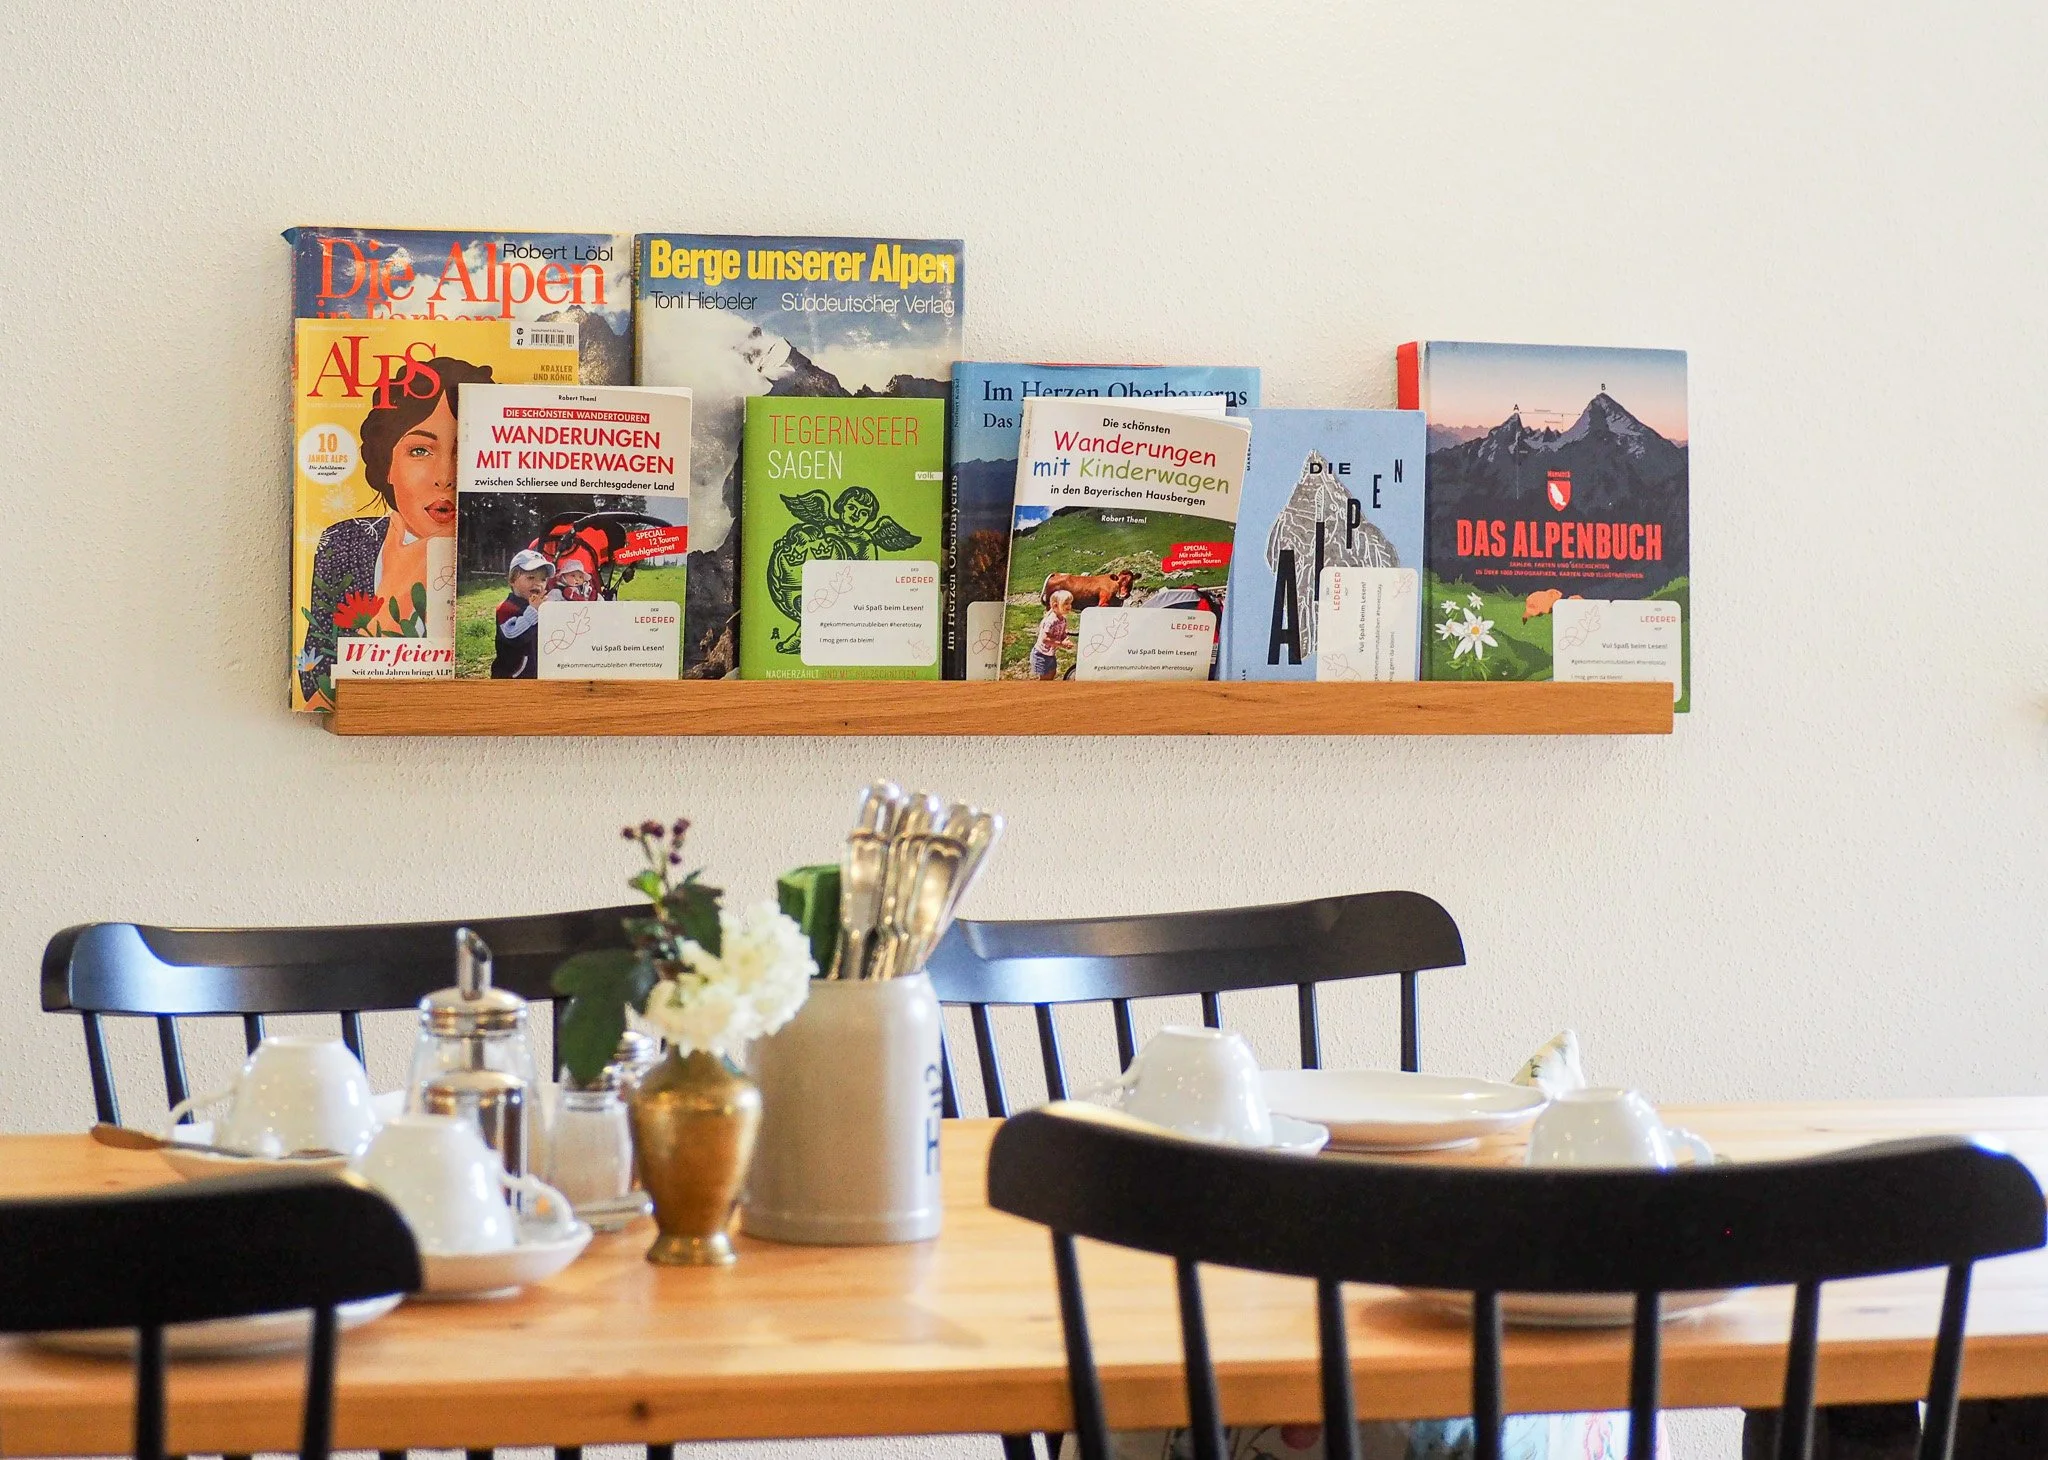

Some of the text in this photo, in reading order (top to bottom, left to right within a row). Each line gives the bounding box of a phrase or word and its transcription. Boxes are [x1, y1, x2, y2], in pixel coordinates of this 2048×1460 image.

[502, 243, 614, 262] Robert Löbl
[650, 239, 955, 289] Berge unserer Alpen
[315, 238, 415, 301] Die
[427, 241, 608, 319] Alpen
[649, 291, 758, 311] Toni Hiebeler
[781, 292, 956, 317] Süddeutscher Verlag
[516, 338, 524, 346] 47
[307, 335, 440, 410] ALPS
[540, 364, 573, 373] KRAXLER
[533, 373, 573, 381] UND KÖNIG
[983, 380, 1013, 401] Im
[1021, 380, 1099, 398] Herzen
[1513, 403, 1520, 411] A
[506, 408, 648, 423] DIE SCHÖNSTEN WANDERTOUREN
[983, 413, 1013, 428] Das
[769, 415, 918, 446] TEGERNSEER
[1102, 418, 1171, 435] Die schönsten
[318, 433, 338, 453] 10
[491, 425, 661, 450] WANDERUNGEN
[1054, 430, 1216, 467] Wanderungen
[331, 454, 348, 463] ALPS
[476, 450, 674, 475] MIT KINDERWAGEN
[768, 449, 843, 480] SAGEN
[917, 472, 935, 480] volk
[1033, 456, 1229, 494] mit Kinderwagen
[1309, 462, 1351, 475] DIE
[474, 477, 675, 491] zwischen Schliersee und Berchtesgadener Land
[1050, 484, 1206, 507] in den Bayerischen Hausbergen
[1101, 514, 1147, 525] Robert Theml
[635, 529, 666, 540] SPECIAL:
[658, 536, 680, 544] Touren
[1456, 519, 1662, 561] DAS ALPENBUCH
[618, 544, 675, 559] rollstuhlgeeignet
[947, 475, 960, 650] Im Herzen Oberbayerns
[895, 576, 934, 584] LEDERER
[1333, 572, 1341, 611] LEDERER
[866, 604, 883, 612] Spaß
[635, 616, 675, 624] LEDERER
[1640, 615, 1677, 623] LEDERER
[1171, 623, 1210, 632] LEDERER
[345, 643, 391, 662] Wir
[1139, 648, 1156, 656] Spaß
[411, 669, 434, 677] bringt
[765, 668, 820, 679] NACHERZÄHLT
